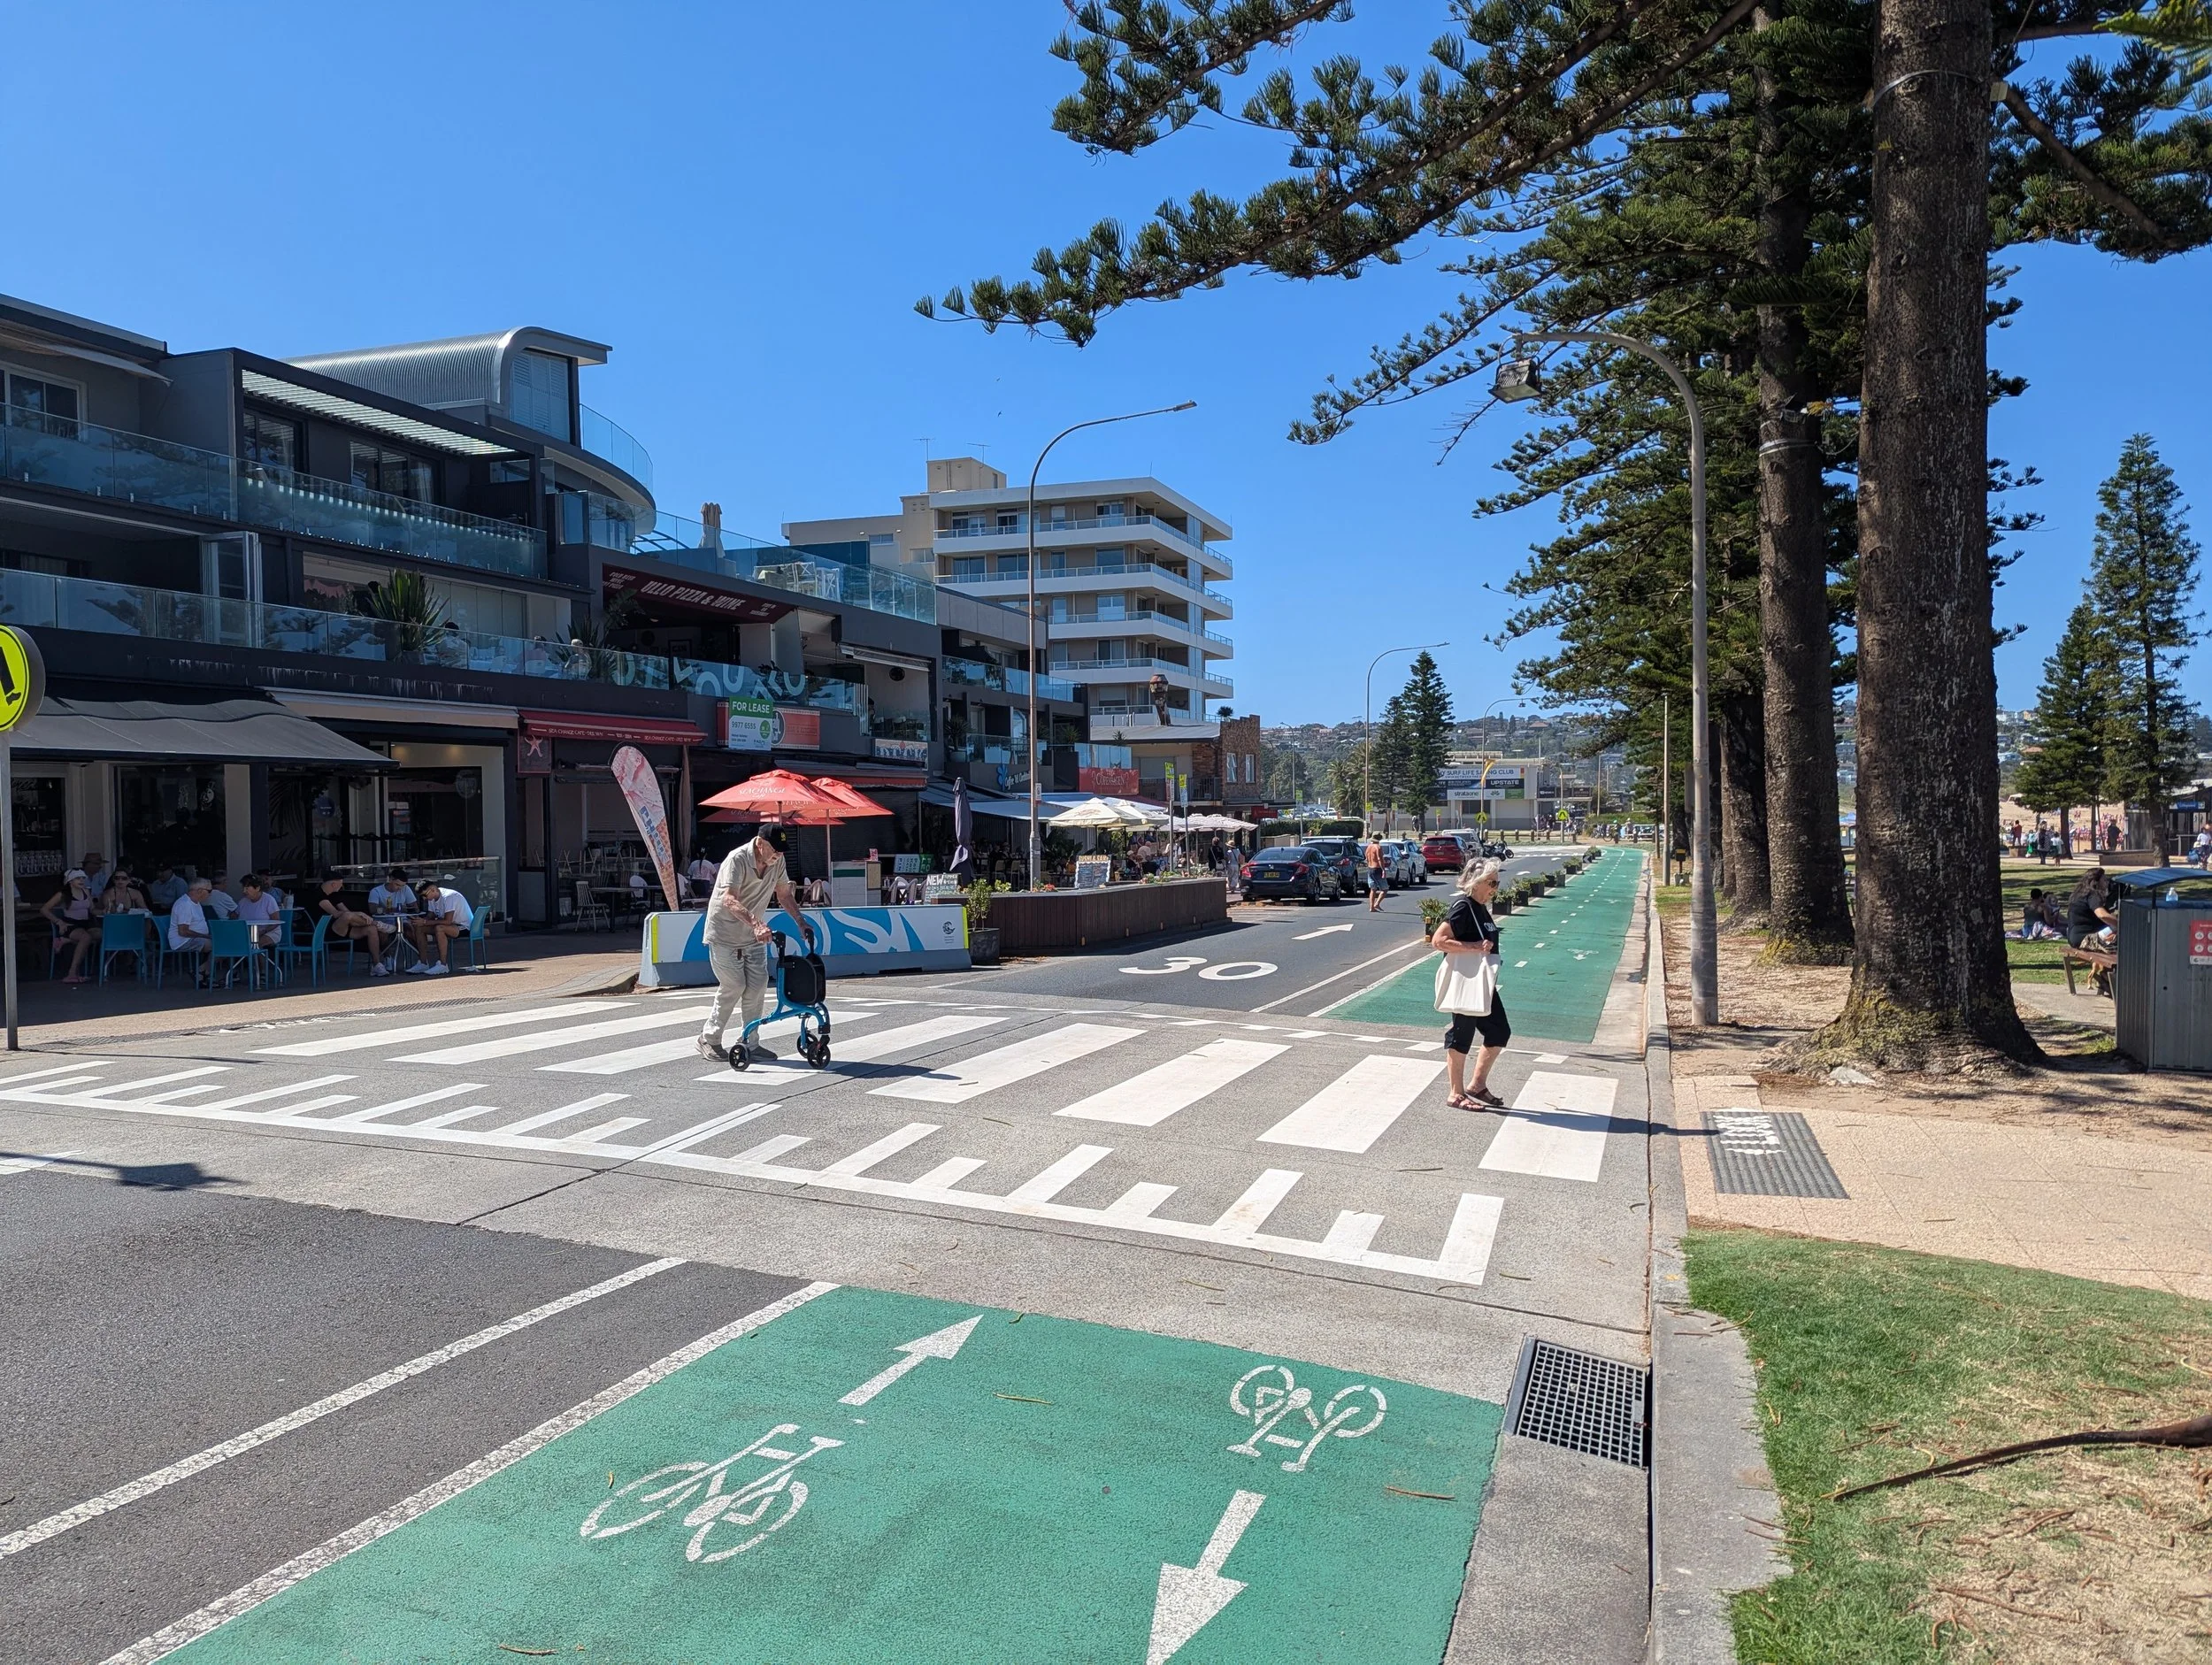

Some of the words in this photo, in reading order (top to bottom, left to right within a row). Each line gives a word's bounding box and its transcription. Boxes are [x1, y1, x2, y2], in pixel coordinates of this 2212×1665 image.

[641, 580, 676, 596] ULLO
[669, 587, 707, 603] PIZZA
[700, 595, 713, 605] &
[710, 595, 746, 610] WINE
[732, 701, 747, 711] FOR
[748, 703, 770, 713] LEASE
[926, 874, 944, 886] NEW
[1118, 956, 1279, 980] 30
